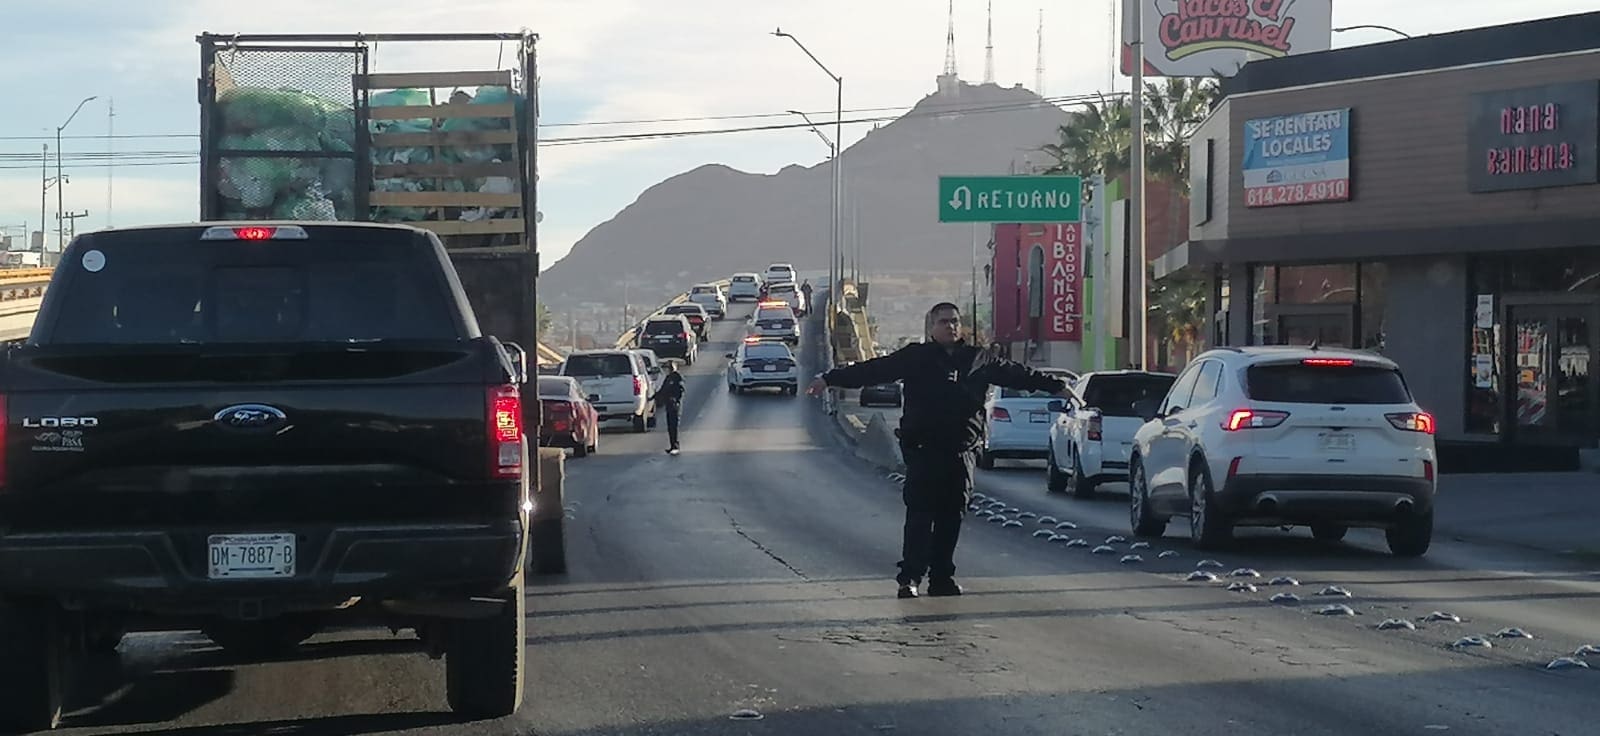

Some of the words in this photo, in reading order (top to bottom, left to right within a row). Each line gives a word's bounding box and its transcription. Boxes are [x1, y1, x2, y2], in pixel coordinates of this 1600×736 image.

[1252, 120, 1271, 139] SE
[1274, 111, 1341, 137] RENTAN
[1262, 132, 1332, 158] LOCALES
[977, 189, 1071, 209] RETORNO
[22, 417, 98, 428] LOBO
[211, 545, 292, 566] DM-7887-B
